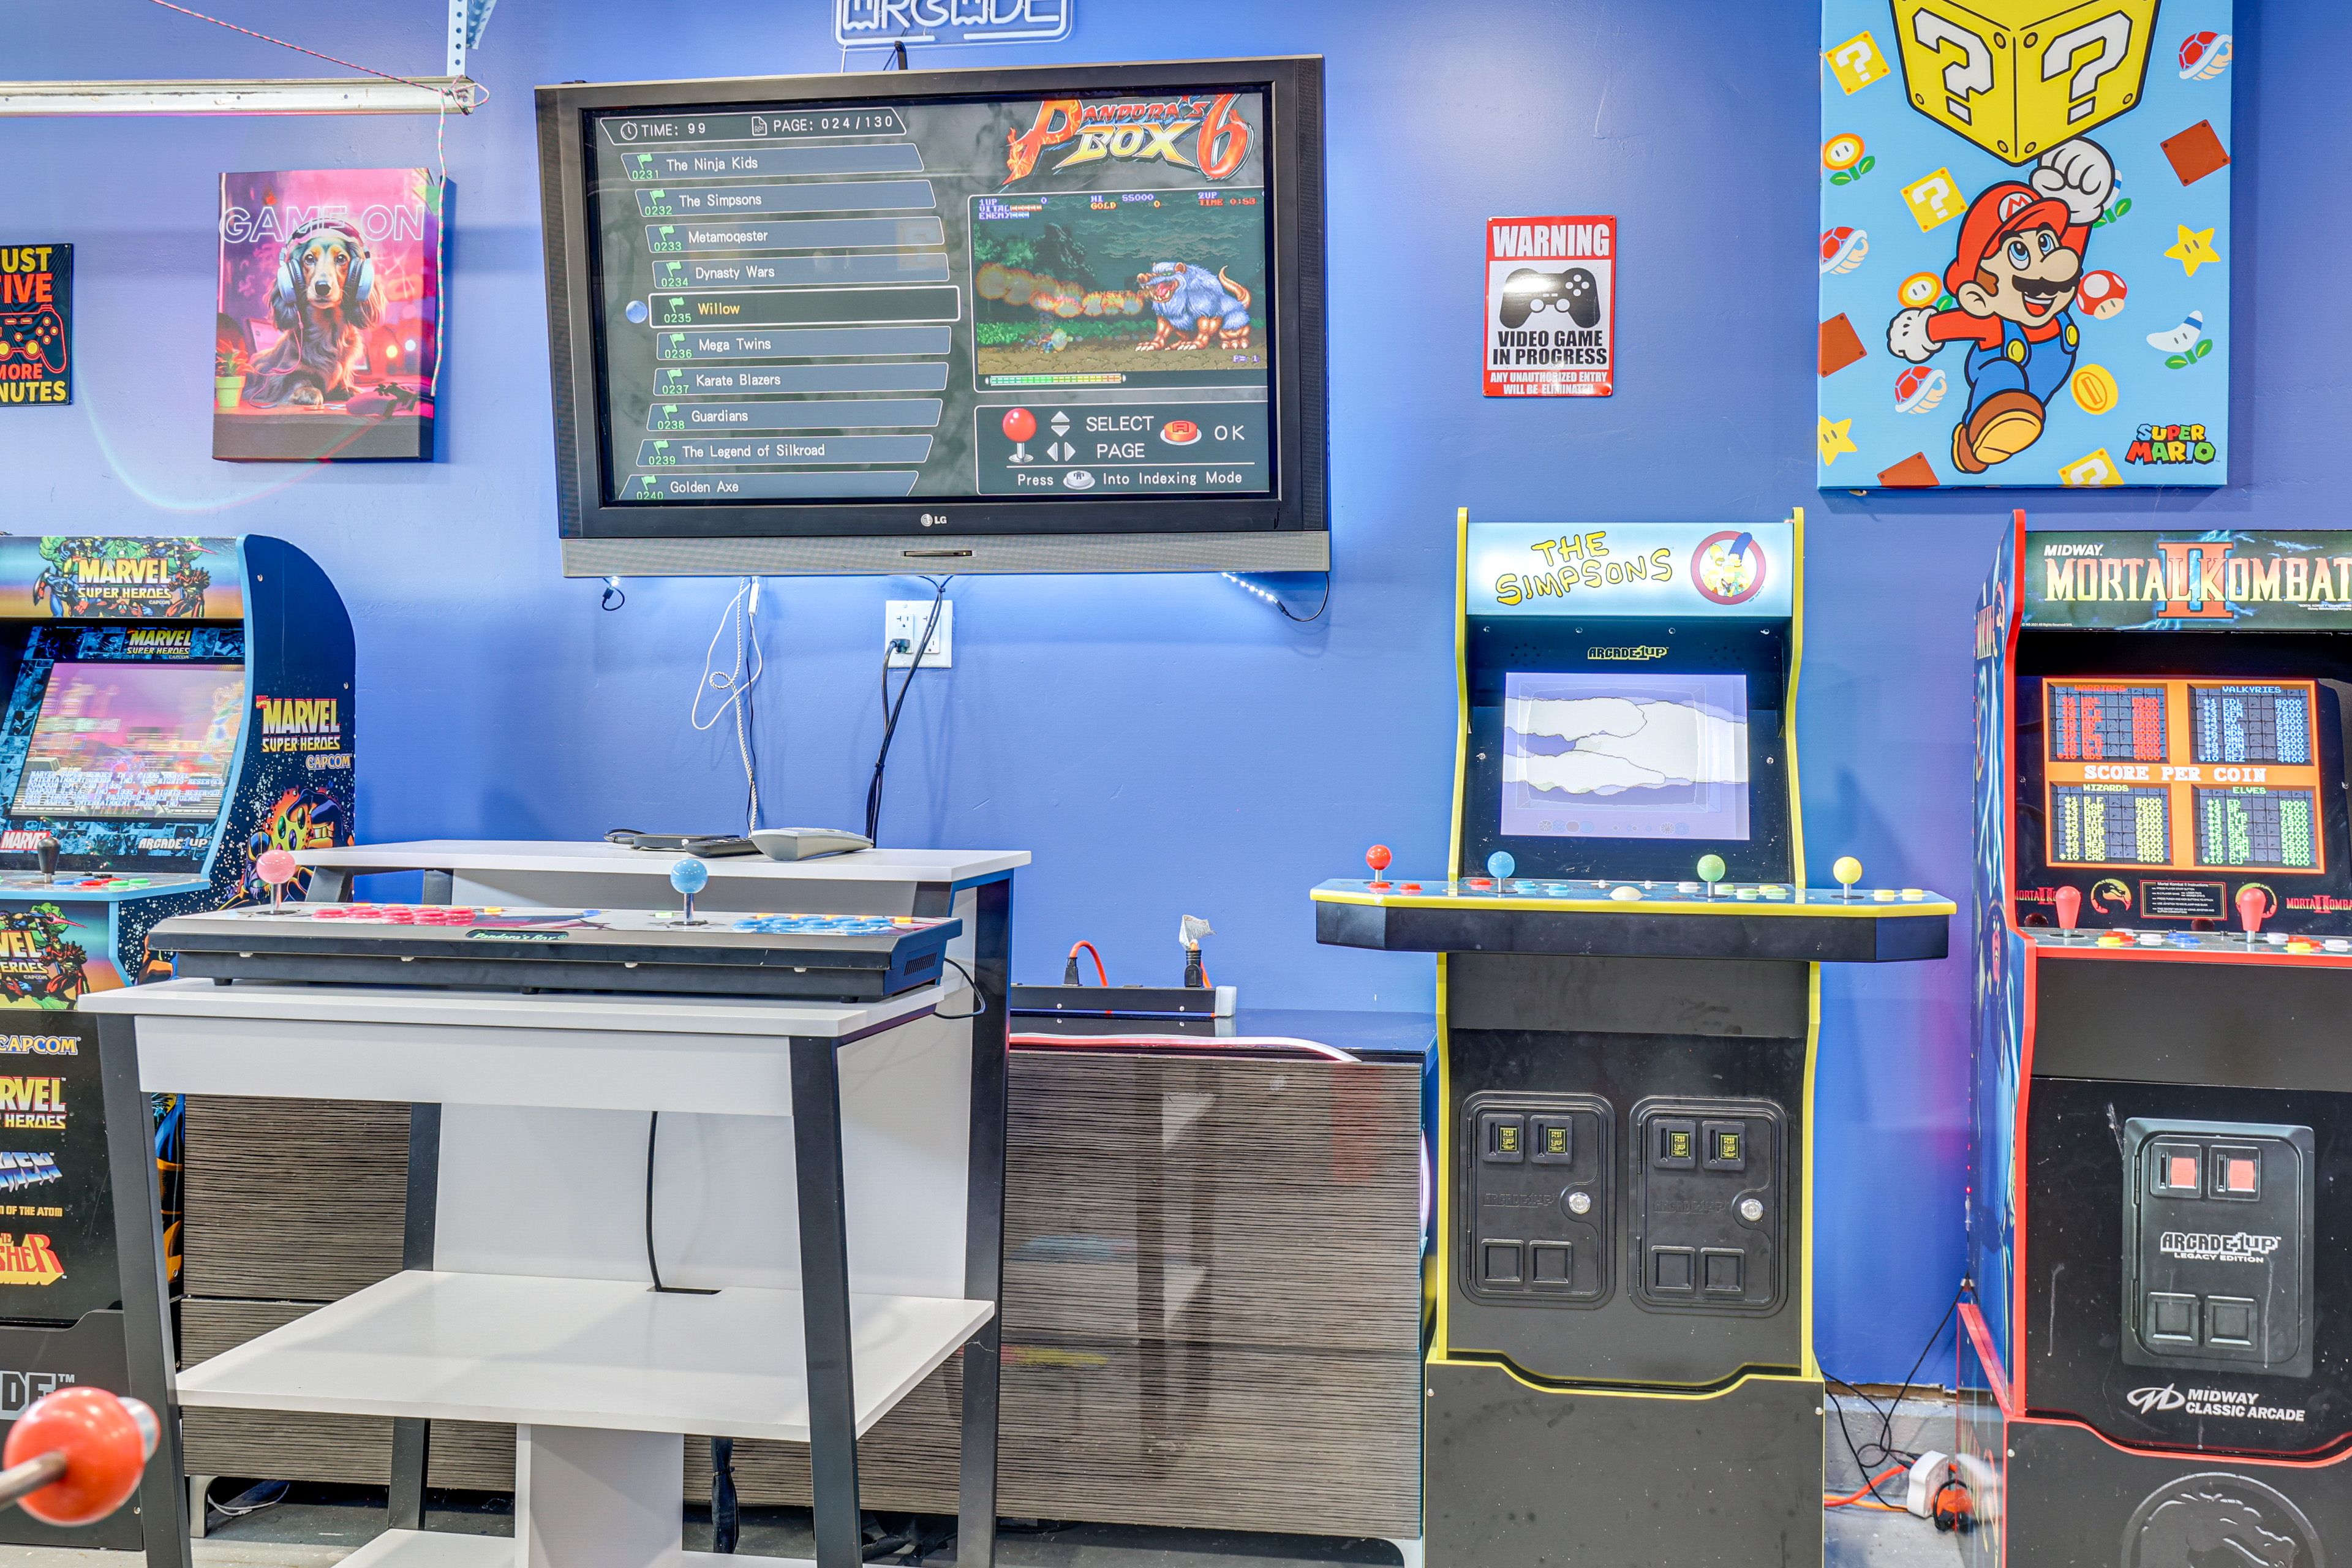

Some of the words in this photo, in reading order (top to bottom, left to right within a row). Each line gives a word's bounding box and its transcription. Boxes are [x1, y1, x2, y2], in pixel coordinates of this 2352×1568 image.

[641, 124, 678, 137] TIME:
[688, 123, 706, 134] 99
[774, 119, 813, 132] PAGE:
[1052, 121, 1201, 170] BOX
[1197, 94, 1255, 182] 6
[667, 159, 688, 171] The
[695, 158, 725, 171] Ninja
[732, 157, 758, 169] Kids
[632, 170, 659, 180] 0231
[679, 195, 701, 207] The
[707, 194, 761, 208] Simpsons
[644, 205, 673, 216] 0232
[219, 206, 347, 243] GAME
[360, 204, 424, 241] ON
[688, 230, 768, 244] Metamoqester
[1493, 224, 1610, 257] WARNING
[654, 241, 682, 251] 0233
[2, 247, 52, 273] UST
[695, 266, 740, 281] Dynasty
[746, 266, 775, 277] Wars
[0, 273, 53, 303] IVE
[661, 277, 688, 287] 0234
[698, 303, 740, 315] Willow
[663, 313, 691, 323] 0235
[699, 339, 729, 352] Mega
[736, 337, 771, 350] Twins
[1498, 331, 1549, 347] VIDEO
[1555, 330, 1602, 346] GAME
[665, 349, 692, 359] 0236
[1493, 349, 1510, 364] IN
[1515, 348, 1607, 364] PROGRESS
[696, 374, 733, 386] Karate
[739, 373, 781, 386] Blazers
[1490, 372, 1508, 382] ANY
[1510, 372, 1577, 382] UNAUTHORIZED
[1579, 372, 1607, 382] ENTRY
[0, 380, 66, 402] NUTES
[662, 385, 689, 394] 0237
[1503, 384, 1525, 394] WILL
[1526, 384, 1538, 394] BE
[692, 410, 748, 423] Guardians
[1086, 415, 1154, 432] SELECT
[657, 420, 685, 430] 0238
[1215, 425, 1245, 442] OK
[2136, 424, 2206, 443] SUPER
[682, 447, 703, 458] The
[710, 445, 751, 459] Legend
[757, 445, 770, 456] of
[777, 444, 825, 456] Silkroad
[1097, 443, 1145, 459] PAGE
[2125, 440, 2217, 466] MARIO
[649, 456, 676, 466] 0239
[1017, 473, 1054, 486] Press
[1103, 473, 1130, 485] Into
[1139, 472, 1196, 486] Indexing
[1205, 471, 1242, 484] Mode
[670, 481, 710, 492] Golden
[717, 481, 739, 492] Axe
[636, 491, 664, 500] 0240
[934, 516, 947, 524] LG
[1531, 531, 1609, 566] THE
[78, 558, 171, 584] MARVEL
[1496, 548, 1673, 606] SIMPSONS
[2044, 558, 2193, 601] MORTAL
[2192, 558, 2352, 601] KOMBAT
[78, 587, 118, 598] SUPER
[129, 630, 191, 646] MARVEL
[262, 698, 341, 734] MARVEL
[262, 737, 297, 753] SUPER
[306, 754, 351, 770] CAPCOM
[2084, 765, 2149, 780] SCORE
[2162, 766, 2201, 781] PER
[2214, 767, 2266, 782] COIN
[0, 1076, 67, 1112] RVEL
[6, 1206, 17, 1215] OF
[19, 1207, 35, 1216] THE
[37, 1207, 62, 1216] ATOM
[2188, 1389, 2259, 1404] MIDWAY
[2185, 1402, 2245, 1417] CLASSIC
[2247, 1407, 2305, 1422] ARCADE
